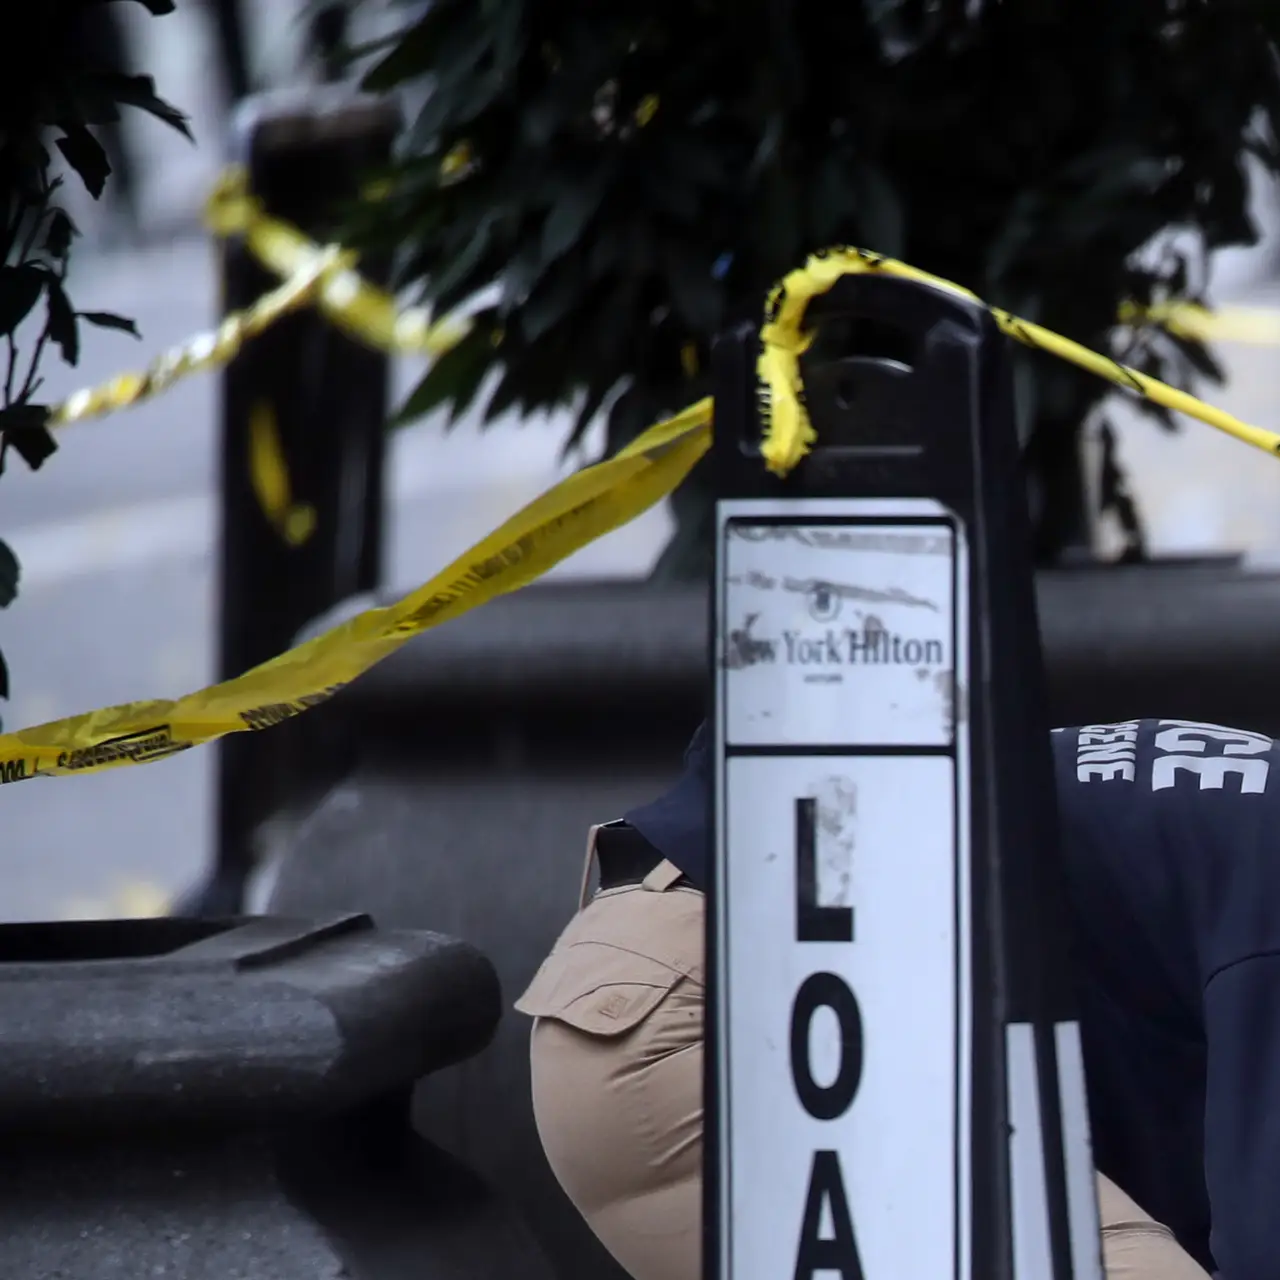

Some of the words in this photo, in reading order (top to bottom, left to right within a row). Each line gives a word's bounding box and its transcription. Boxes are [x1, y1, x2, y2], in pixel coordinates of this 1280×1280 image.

[782, 629, 842, 664] York
[847, 628, 944, 665] Hilton
[1077, 719, 1141, 783] CENE
